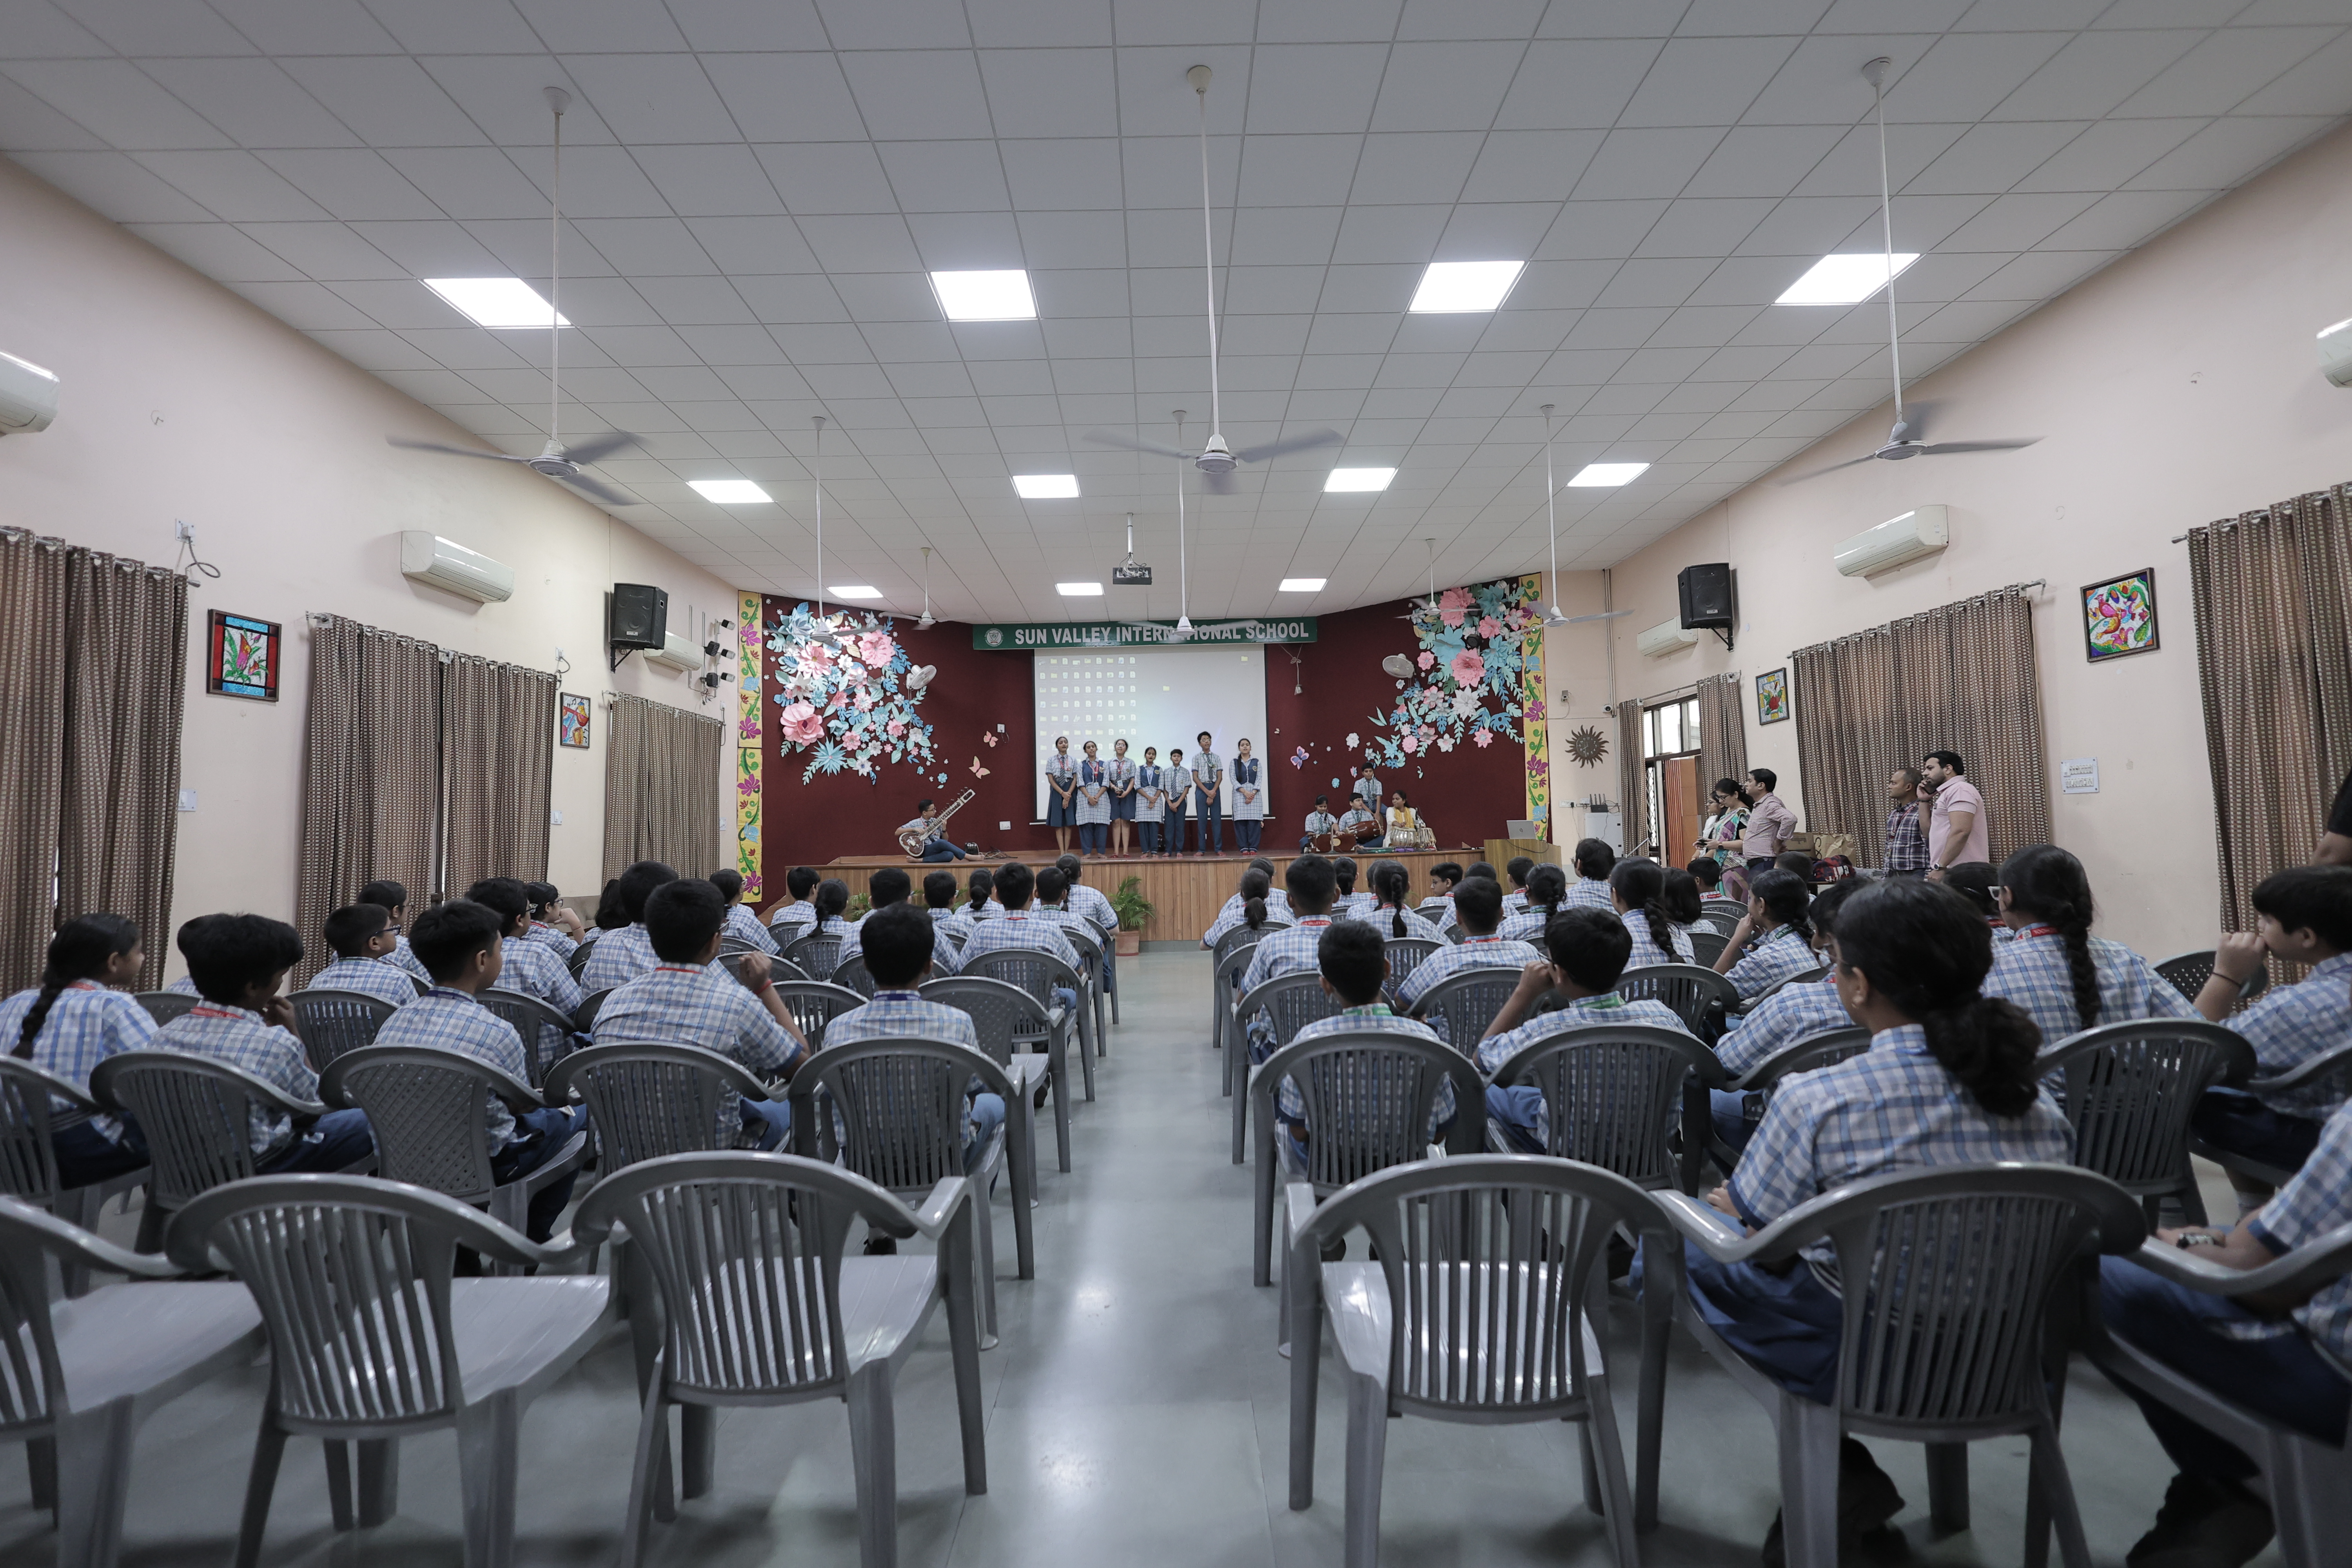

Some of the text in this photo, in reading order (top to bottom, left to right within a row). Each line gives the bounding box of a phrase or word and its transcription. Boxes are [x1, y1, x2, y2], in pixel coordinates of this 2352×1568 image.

[1015, 629, 1047, 644] SUN
[1052, 627, 1111, 643] VALLEY
[1116, 624, 1241, 642] INTERNIONAL
[1246, 622, 1308, 639] SCHOOL
